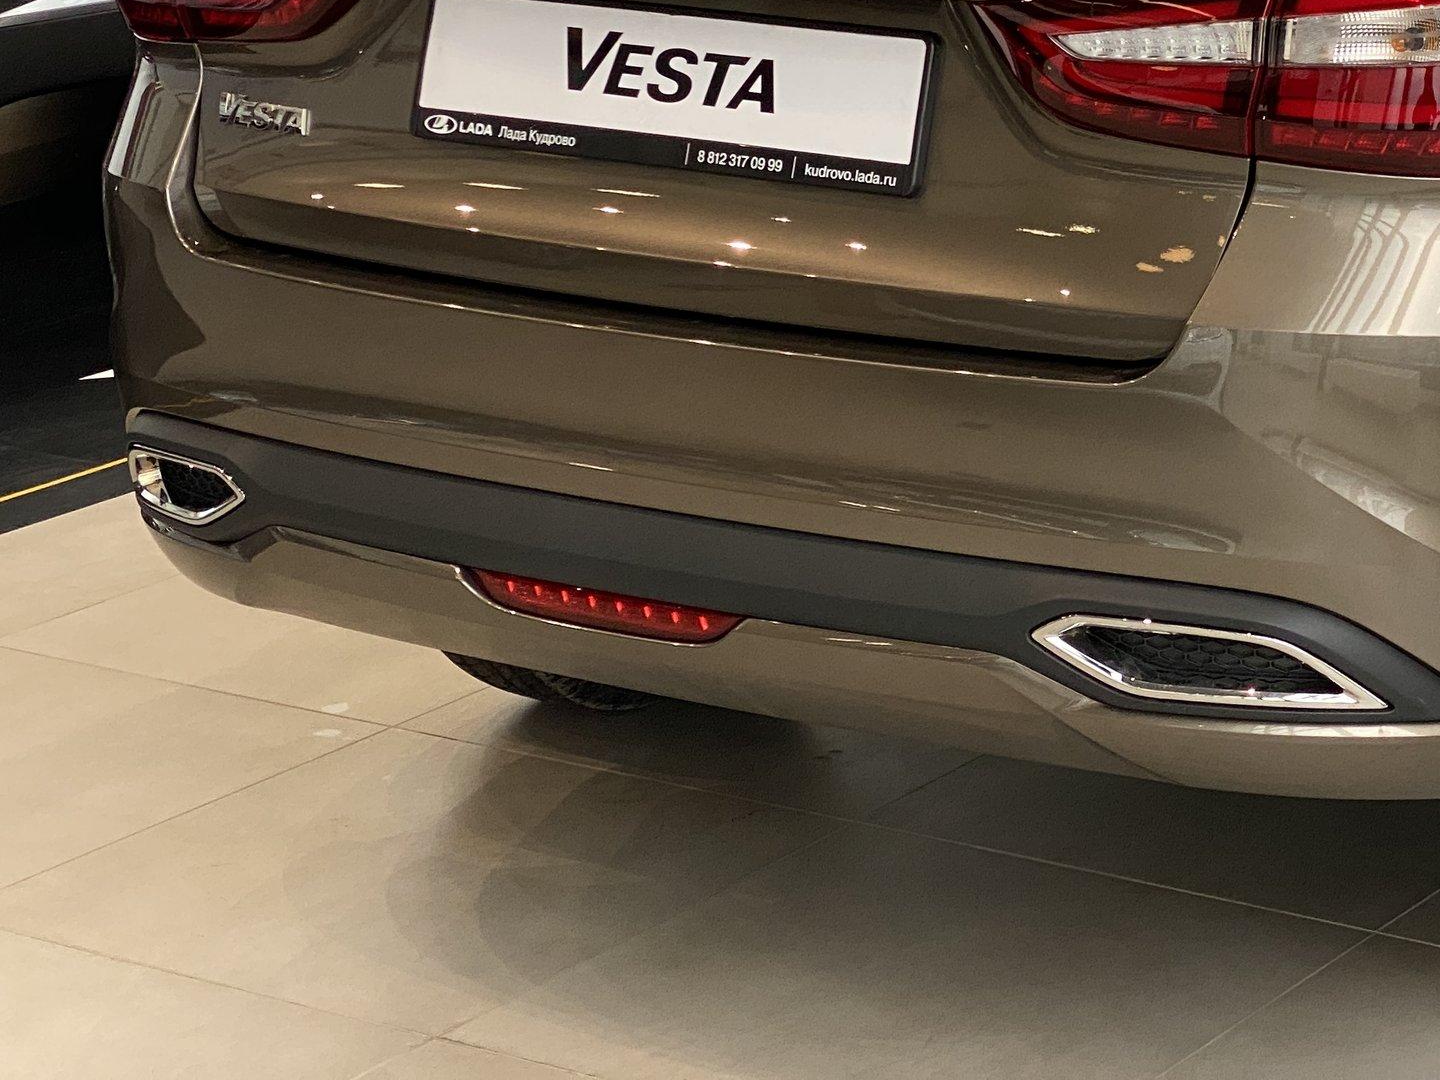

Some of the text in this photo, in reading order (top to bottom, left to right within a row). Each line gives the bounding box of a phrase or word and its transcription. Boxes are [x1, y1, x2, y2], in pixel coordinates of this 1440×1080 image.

[566, 25, 776, 115] VESTA
[219, 91, 312, 137] VESTA
[458, 120, 494, 137] LADA
[497, 125, 577, 147] Лада Кудрово
[696, 149, 783, 172] 8 812 317 09 99
[804, 163, 898, 187] kudrovo.lada.ru
